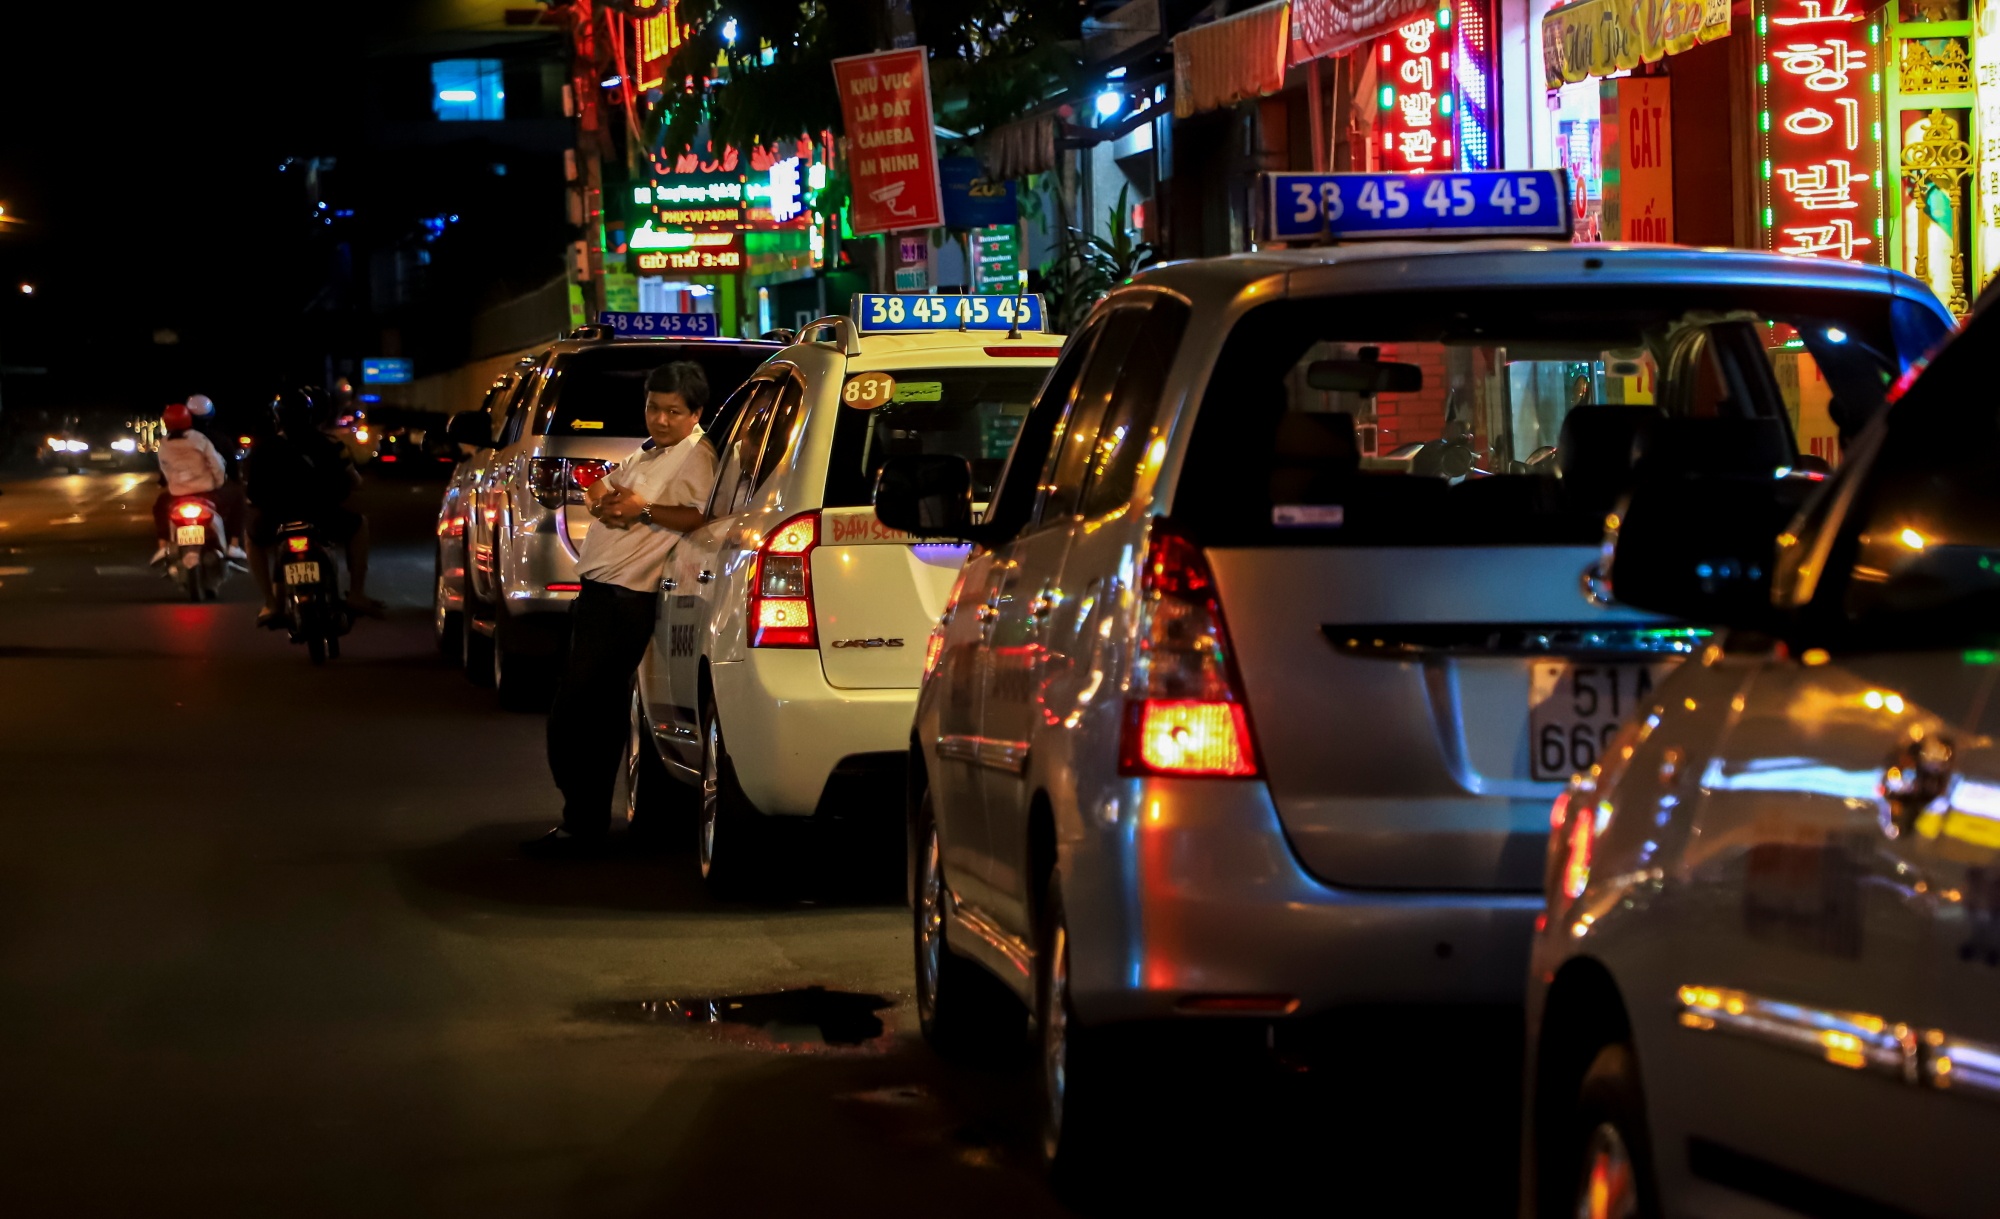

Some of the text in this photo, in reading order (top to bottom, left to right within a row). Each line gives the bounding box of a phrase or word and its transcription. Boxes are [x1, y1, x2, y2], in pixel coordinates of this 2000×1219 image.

[850, 77, 878, 96] KHU
[1629, 82, 1662, 169] CẮT
[859, 126, 915, 149] CAMERA
[860, 153, 919, 176] AN NINH
[1291, 177, 1540, 222] 38 45 45 45
[871, 298, 1031, 323] 38 45 45 45
[607, 314, 708, 332] 38 45 45 45
[845, 379, 892, 402] 831
[831, 637, 905, 649] CARENS
